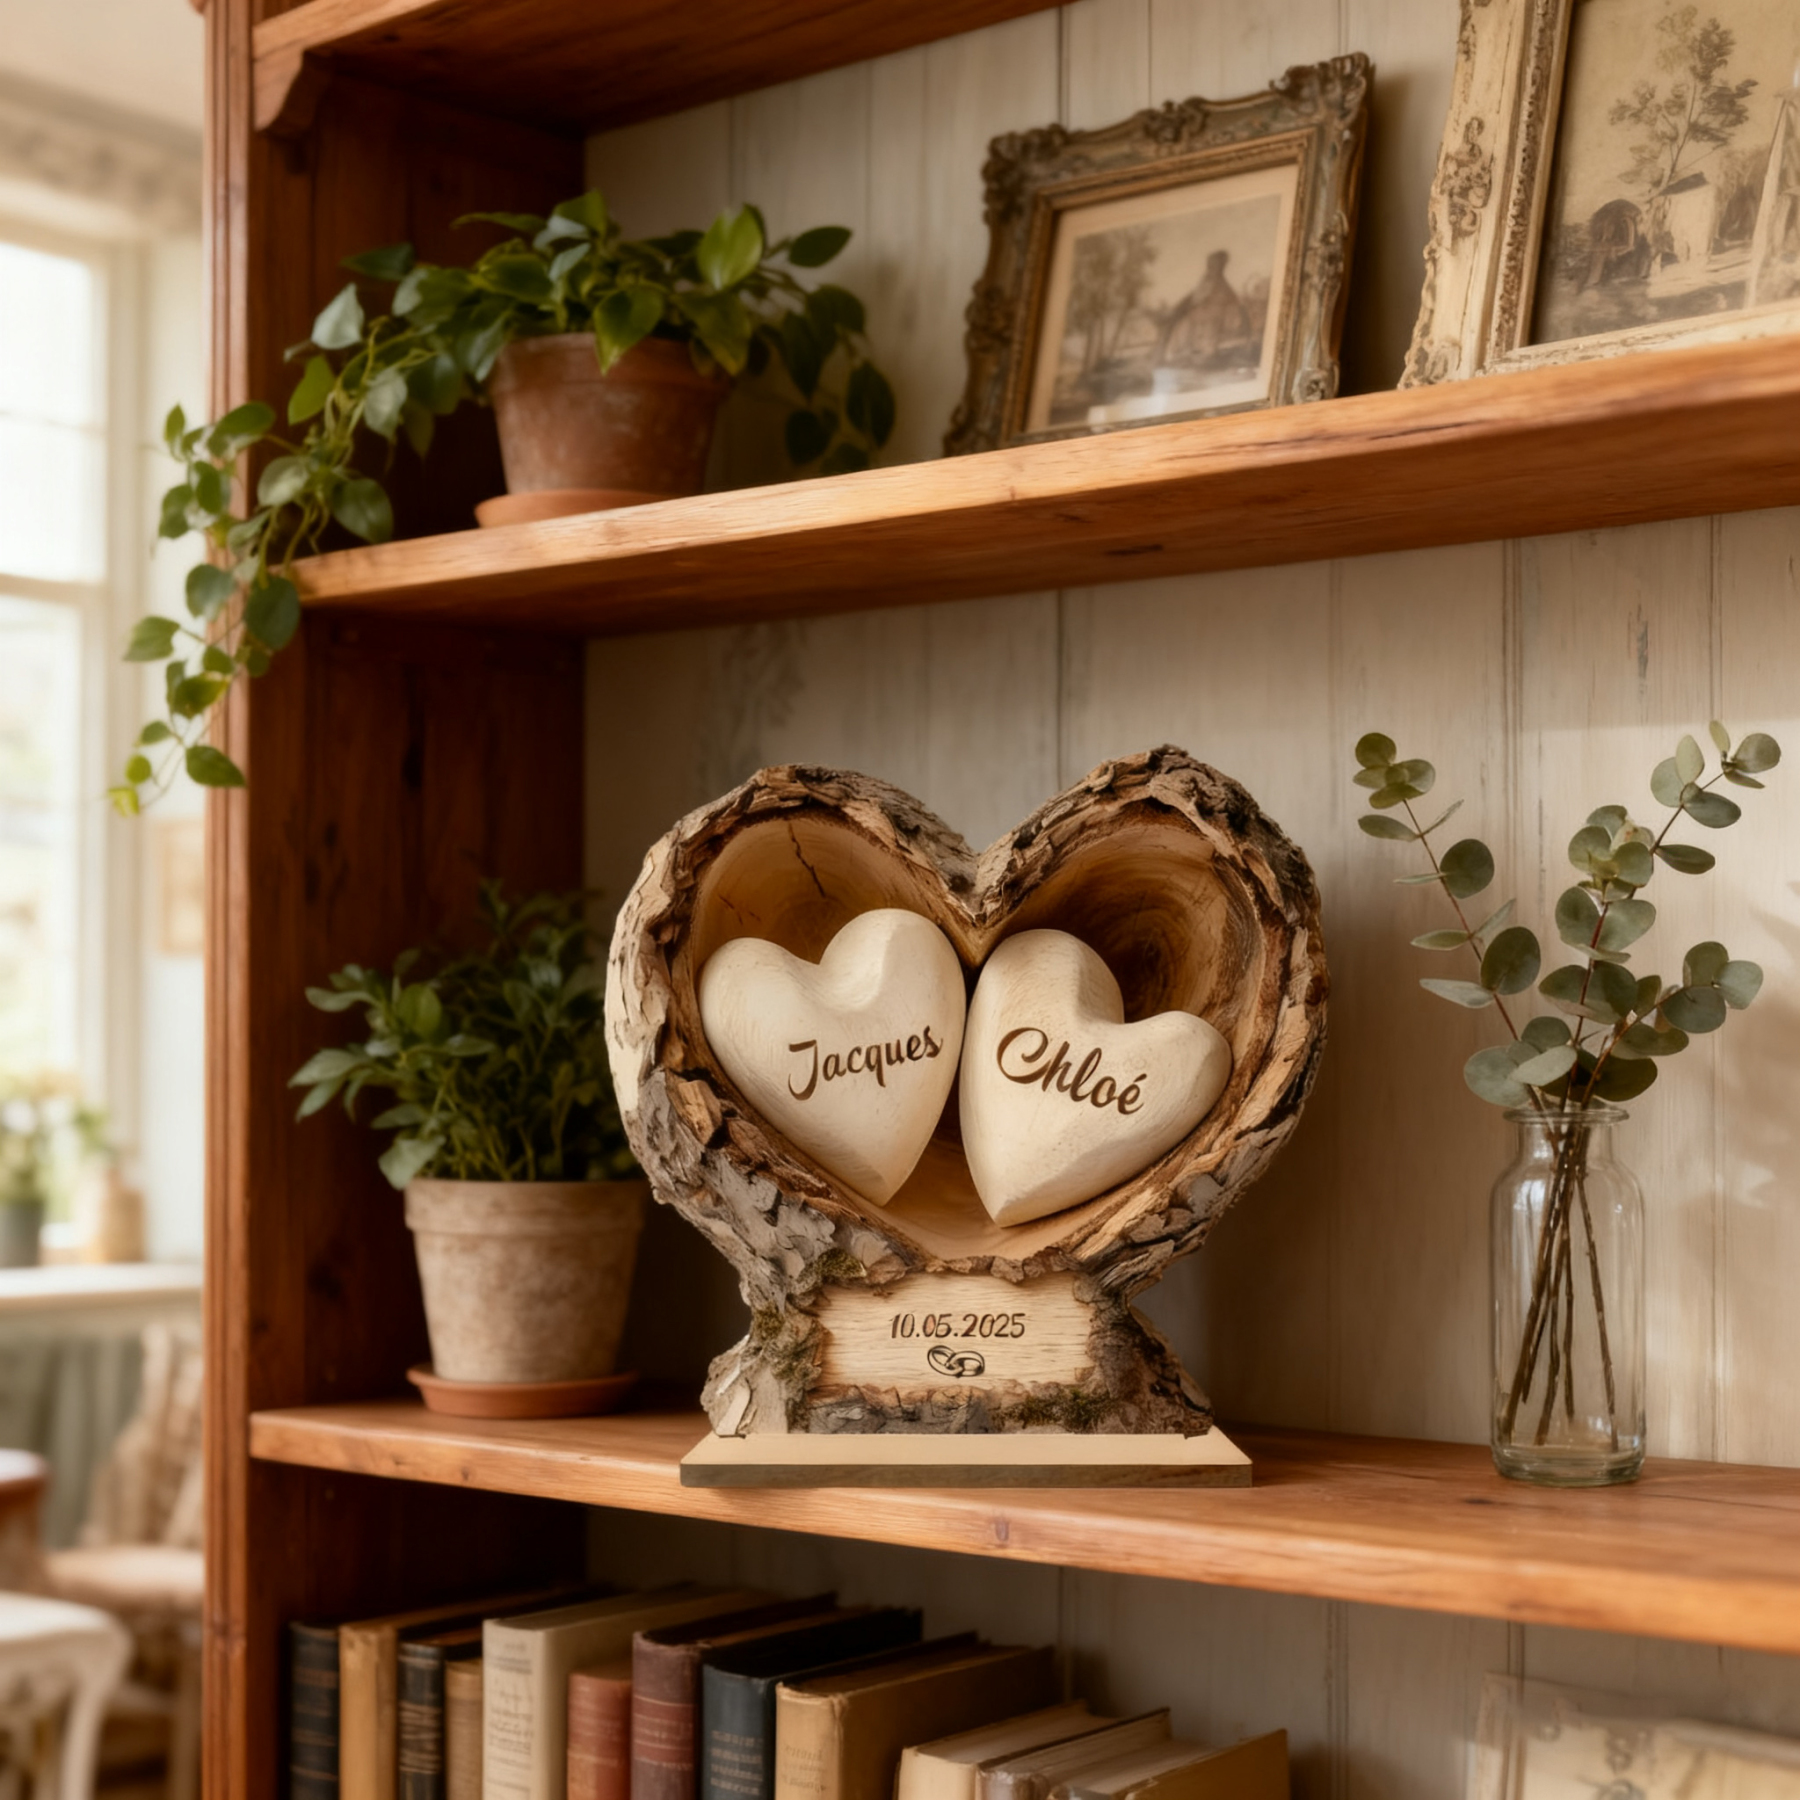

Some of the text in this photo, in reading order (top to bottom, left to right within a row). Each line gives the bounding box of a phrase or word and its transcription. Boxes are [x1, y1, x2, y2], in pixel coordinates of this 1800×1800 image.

[788, 1026, 943, 1101] Jacques
[997, 1027, 1147, 1115] Chloé
[890, 1312, 1026, 1339] 10.05.2025
